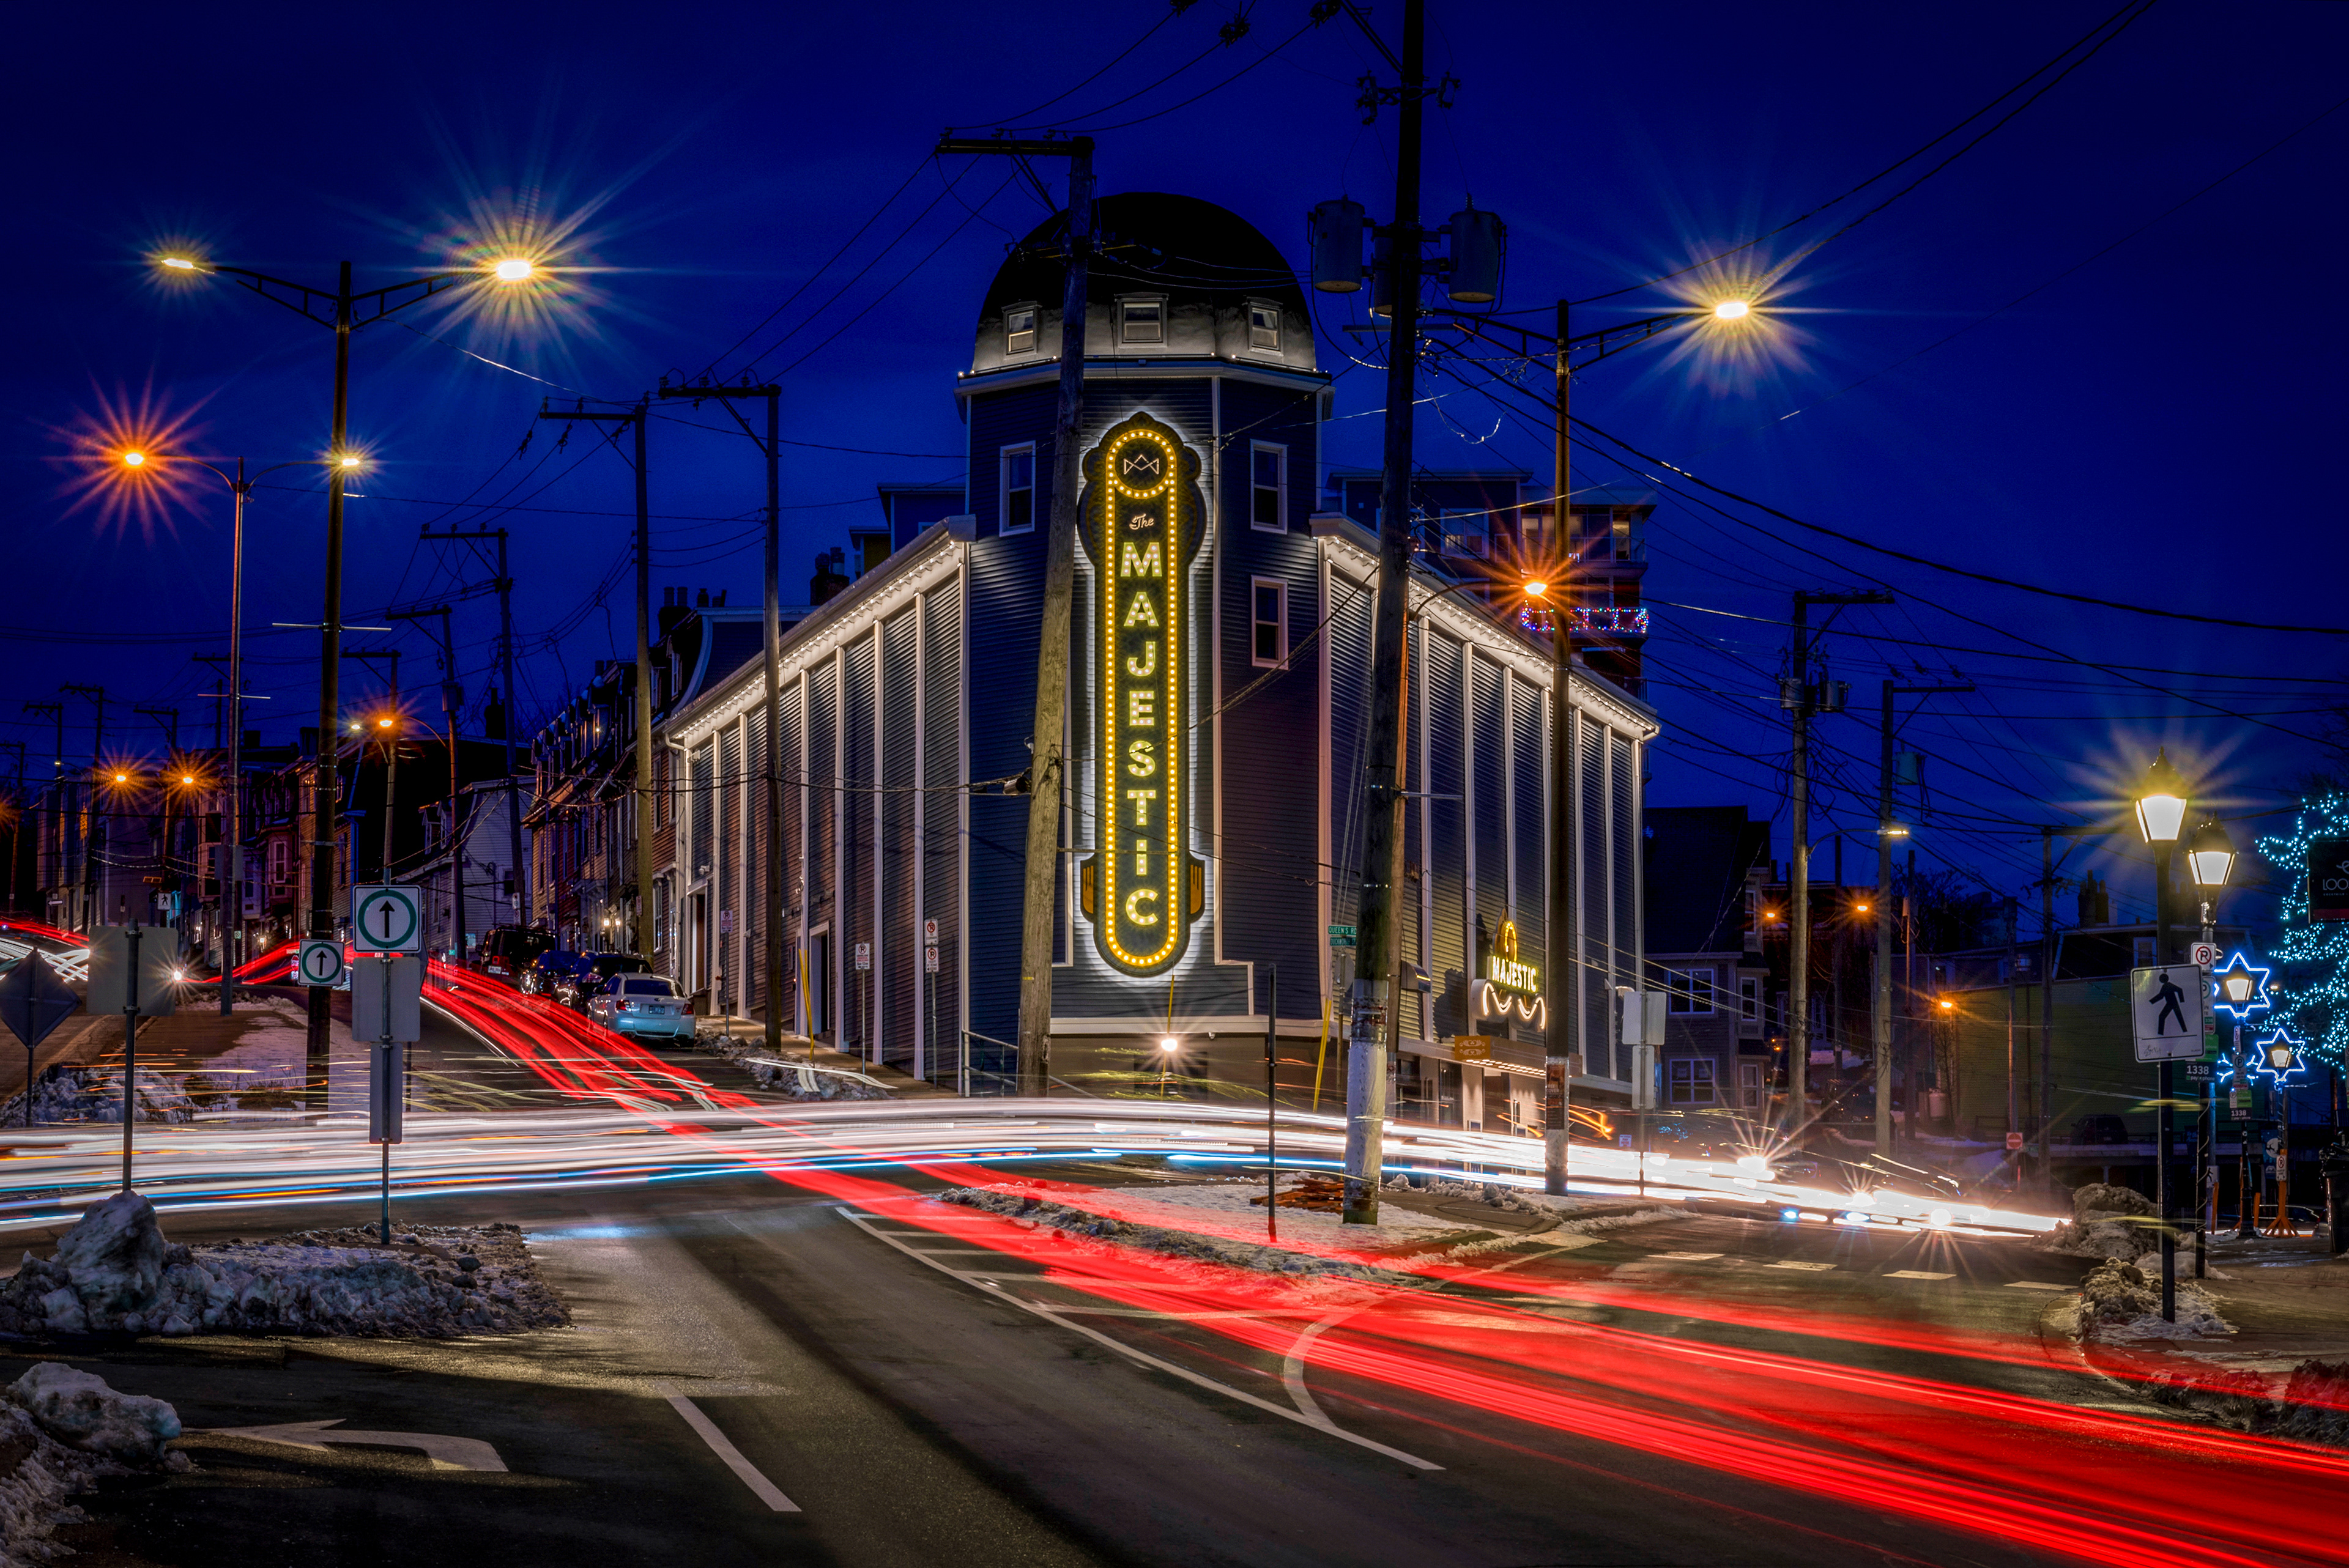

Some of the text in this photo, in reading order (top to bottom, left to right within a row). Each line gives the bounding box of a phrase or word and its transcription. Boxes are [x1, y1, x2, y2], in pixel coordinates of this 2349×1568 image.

[1129, 513, 1154, 530] The
[1120, 542, 1162, 926] MAJESTIC
[2323, 878, 2349, 890] LOO
[1493, 955, 1537, 992] MAJESTIC
[2187, 1065, 2210, 1074] 1338
